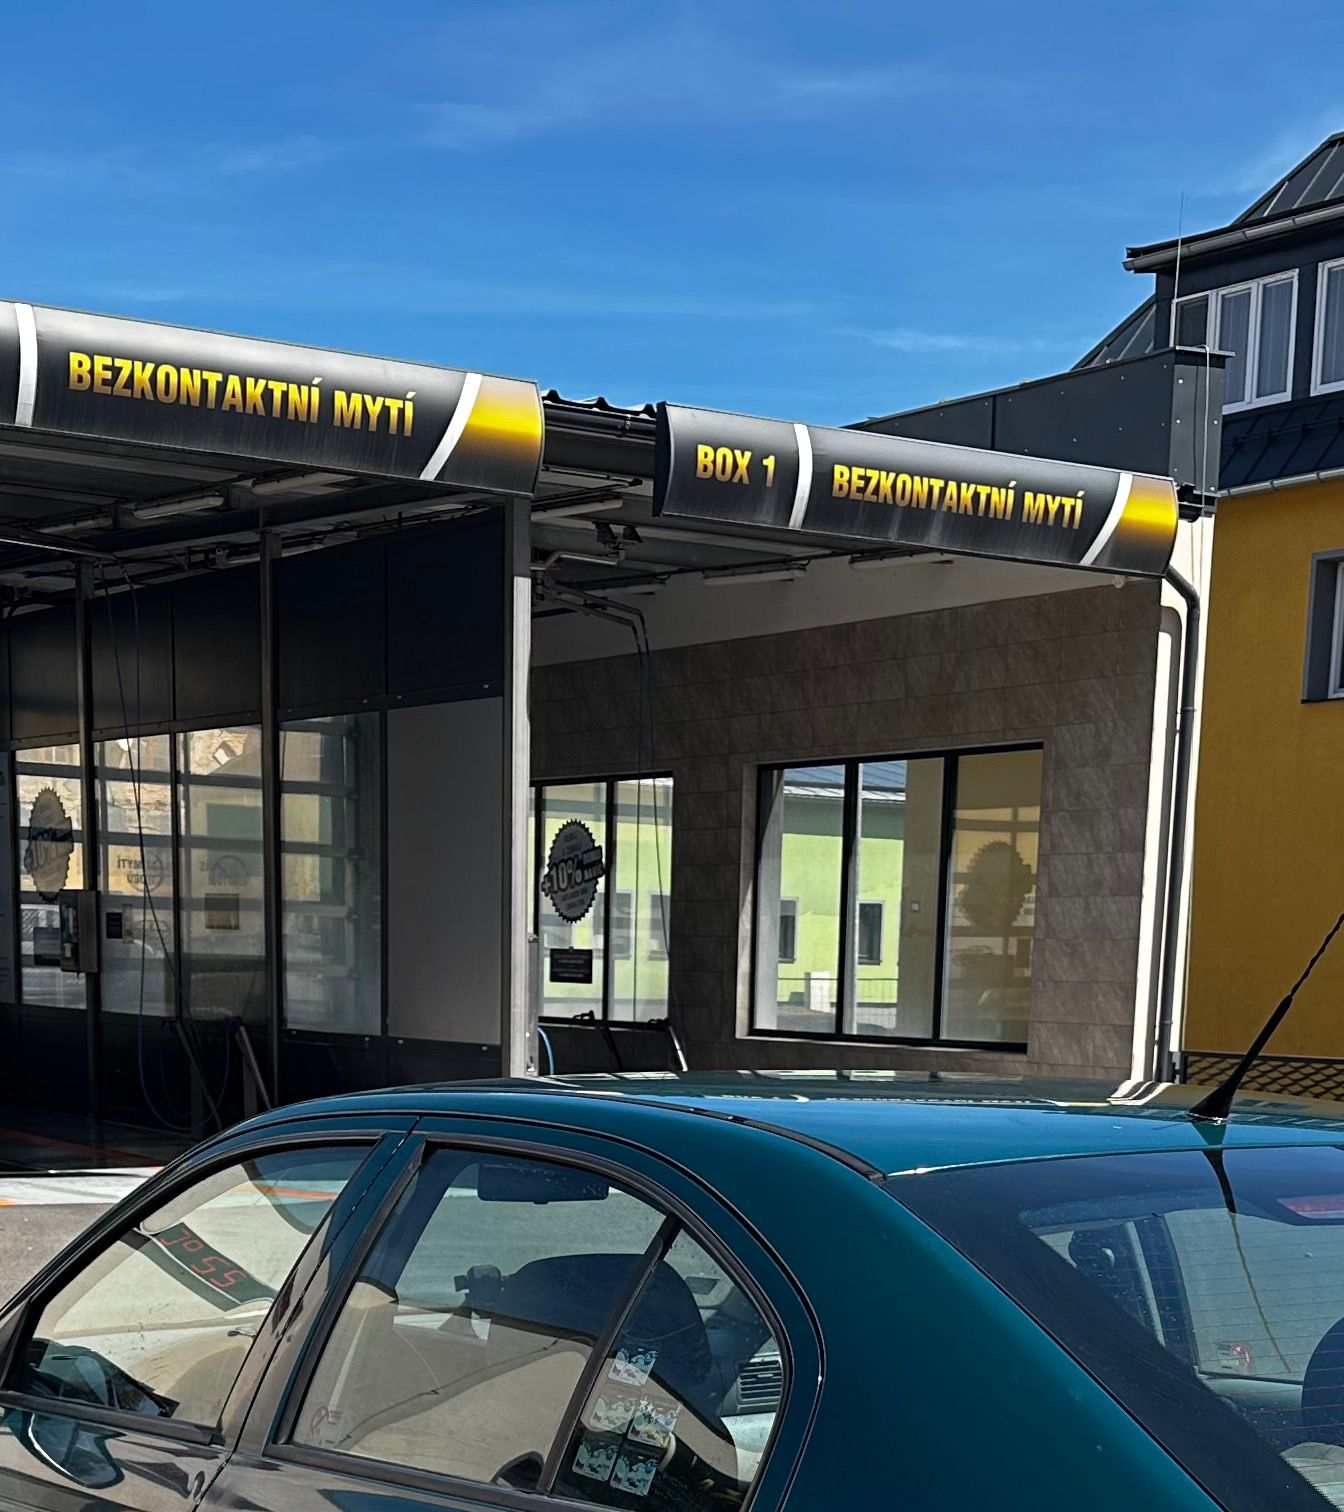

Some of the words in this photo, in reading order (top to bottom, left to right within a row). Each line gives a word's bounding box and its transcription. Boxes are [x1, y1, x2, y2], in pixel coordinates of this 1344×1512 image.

[69, 352, 320, 424] BEZKONTAKTNÍ
[334, 390, 414, 437] MYTÍ
[696, 444, 750, 484] BOX
[763, 455, 775, 487] 1
[833, 463, 1015, 520] BEZKONTAKTNÍ
[1022, 490, 1084, 530] MYTÍ
